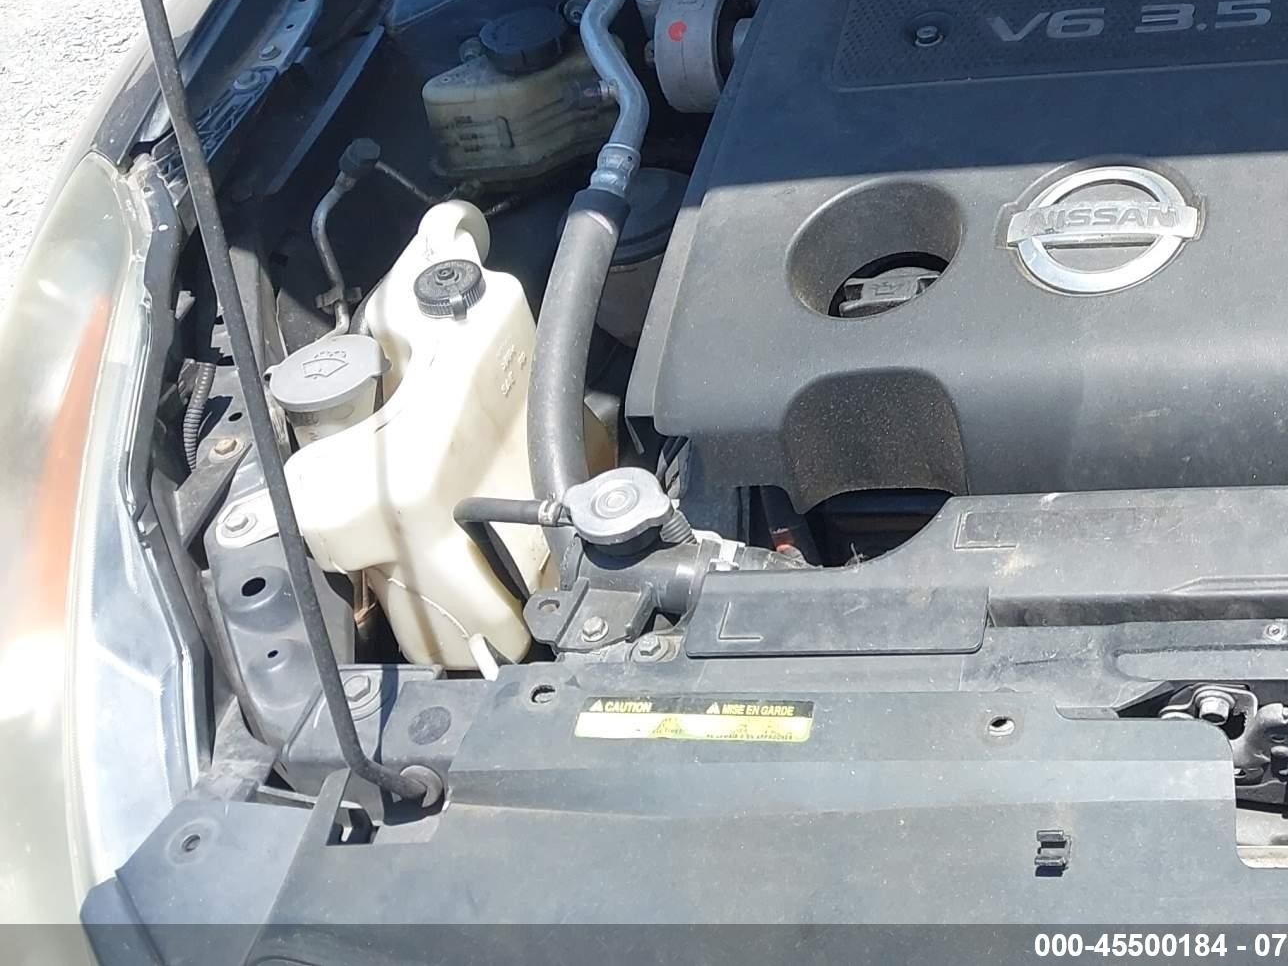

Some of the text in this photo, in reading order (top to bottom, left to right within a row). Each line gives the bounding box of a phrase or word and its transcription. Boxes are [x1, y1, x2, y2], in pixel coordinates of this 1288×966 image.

[988, 7, 1105, 42] V6
[1025, 207, 1178, 230] NISSAN
[604, 700, 653, 713] CAUTION
[721, 703, 795, 717] MISE EN GARDE
